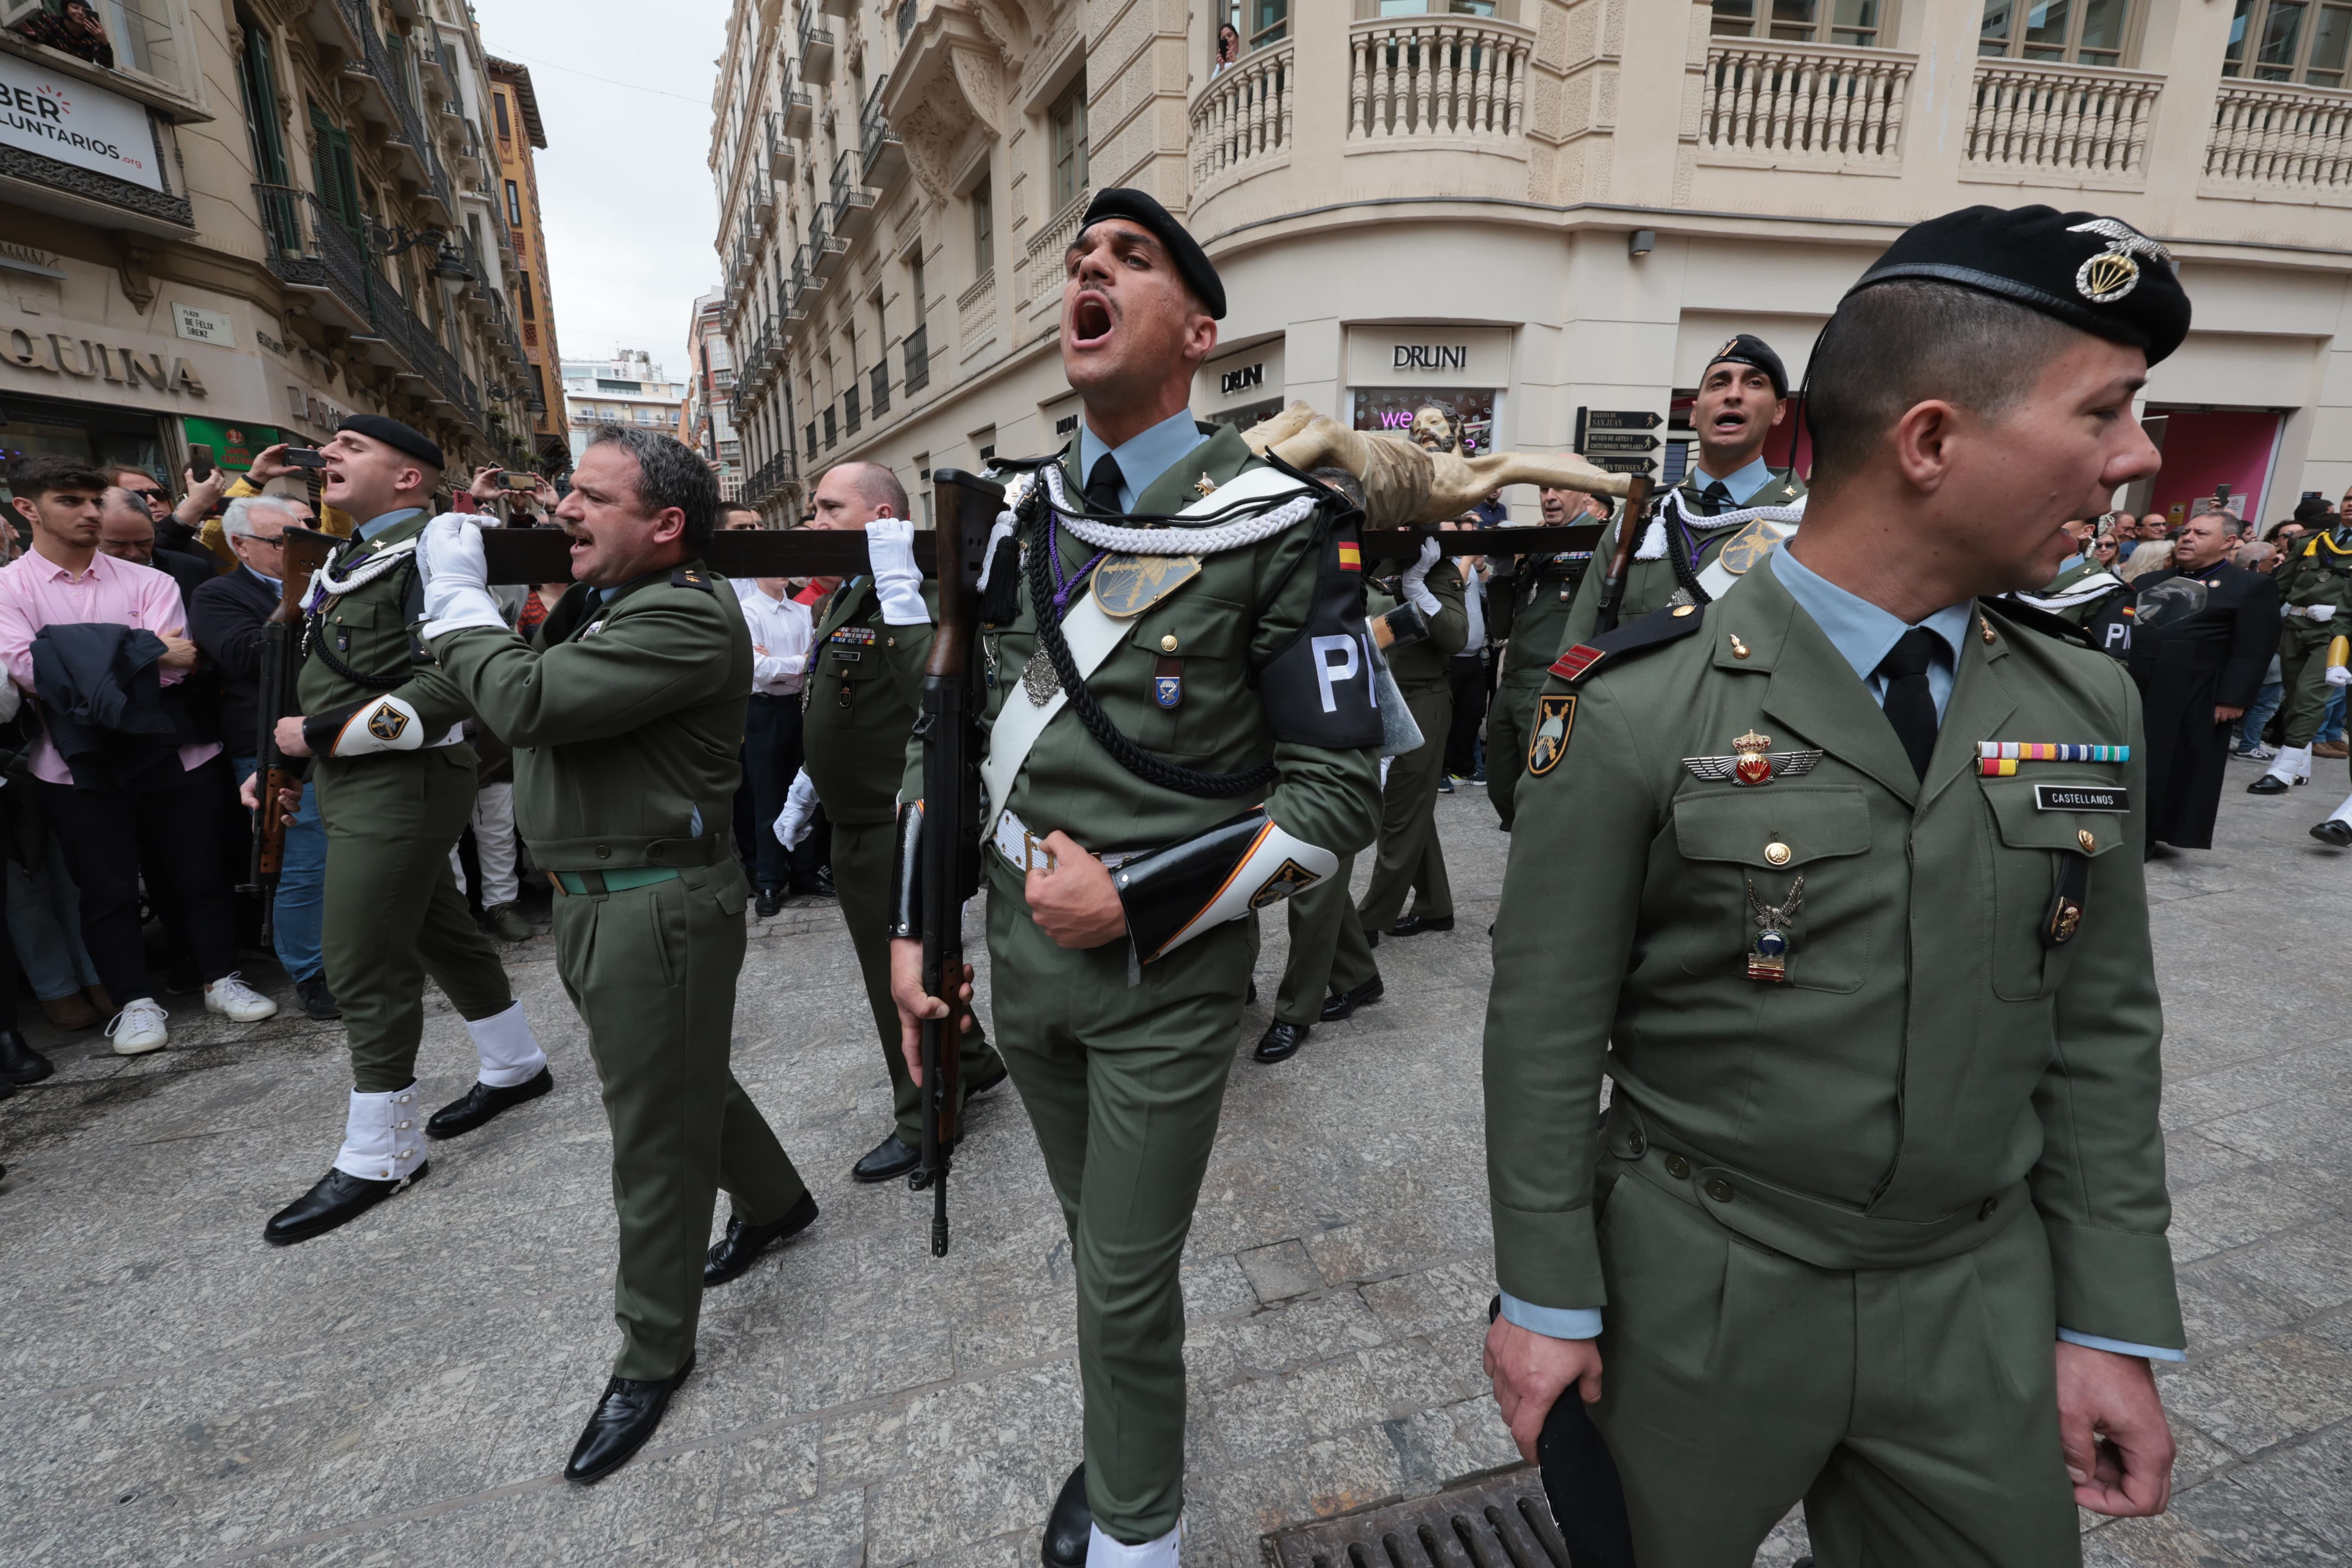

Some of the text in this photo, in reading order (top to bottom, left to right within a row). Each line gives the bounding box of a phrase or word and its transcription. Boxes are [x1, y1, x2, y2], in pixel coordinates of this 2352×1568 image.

[183, 309, 199, 317] PLAZA
[185, 317, 194, 326] DE
[1394, 345, 1467, 368] DRUNI
[1221, 363, 1263, 394] DRUNI
[1381, 412, 1413, 428] we
[1592, 419, 1605, 427] SAN
[2052, 793, 2114, 805] CASTELLANOS
